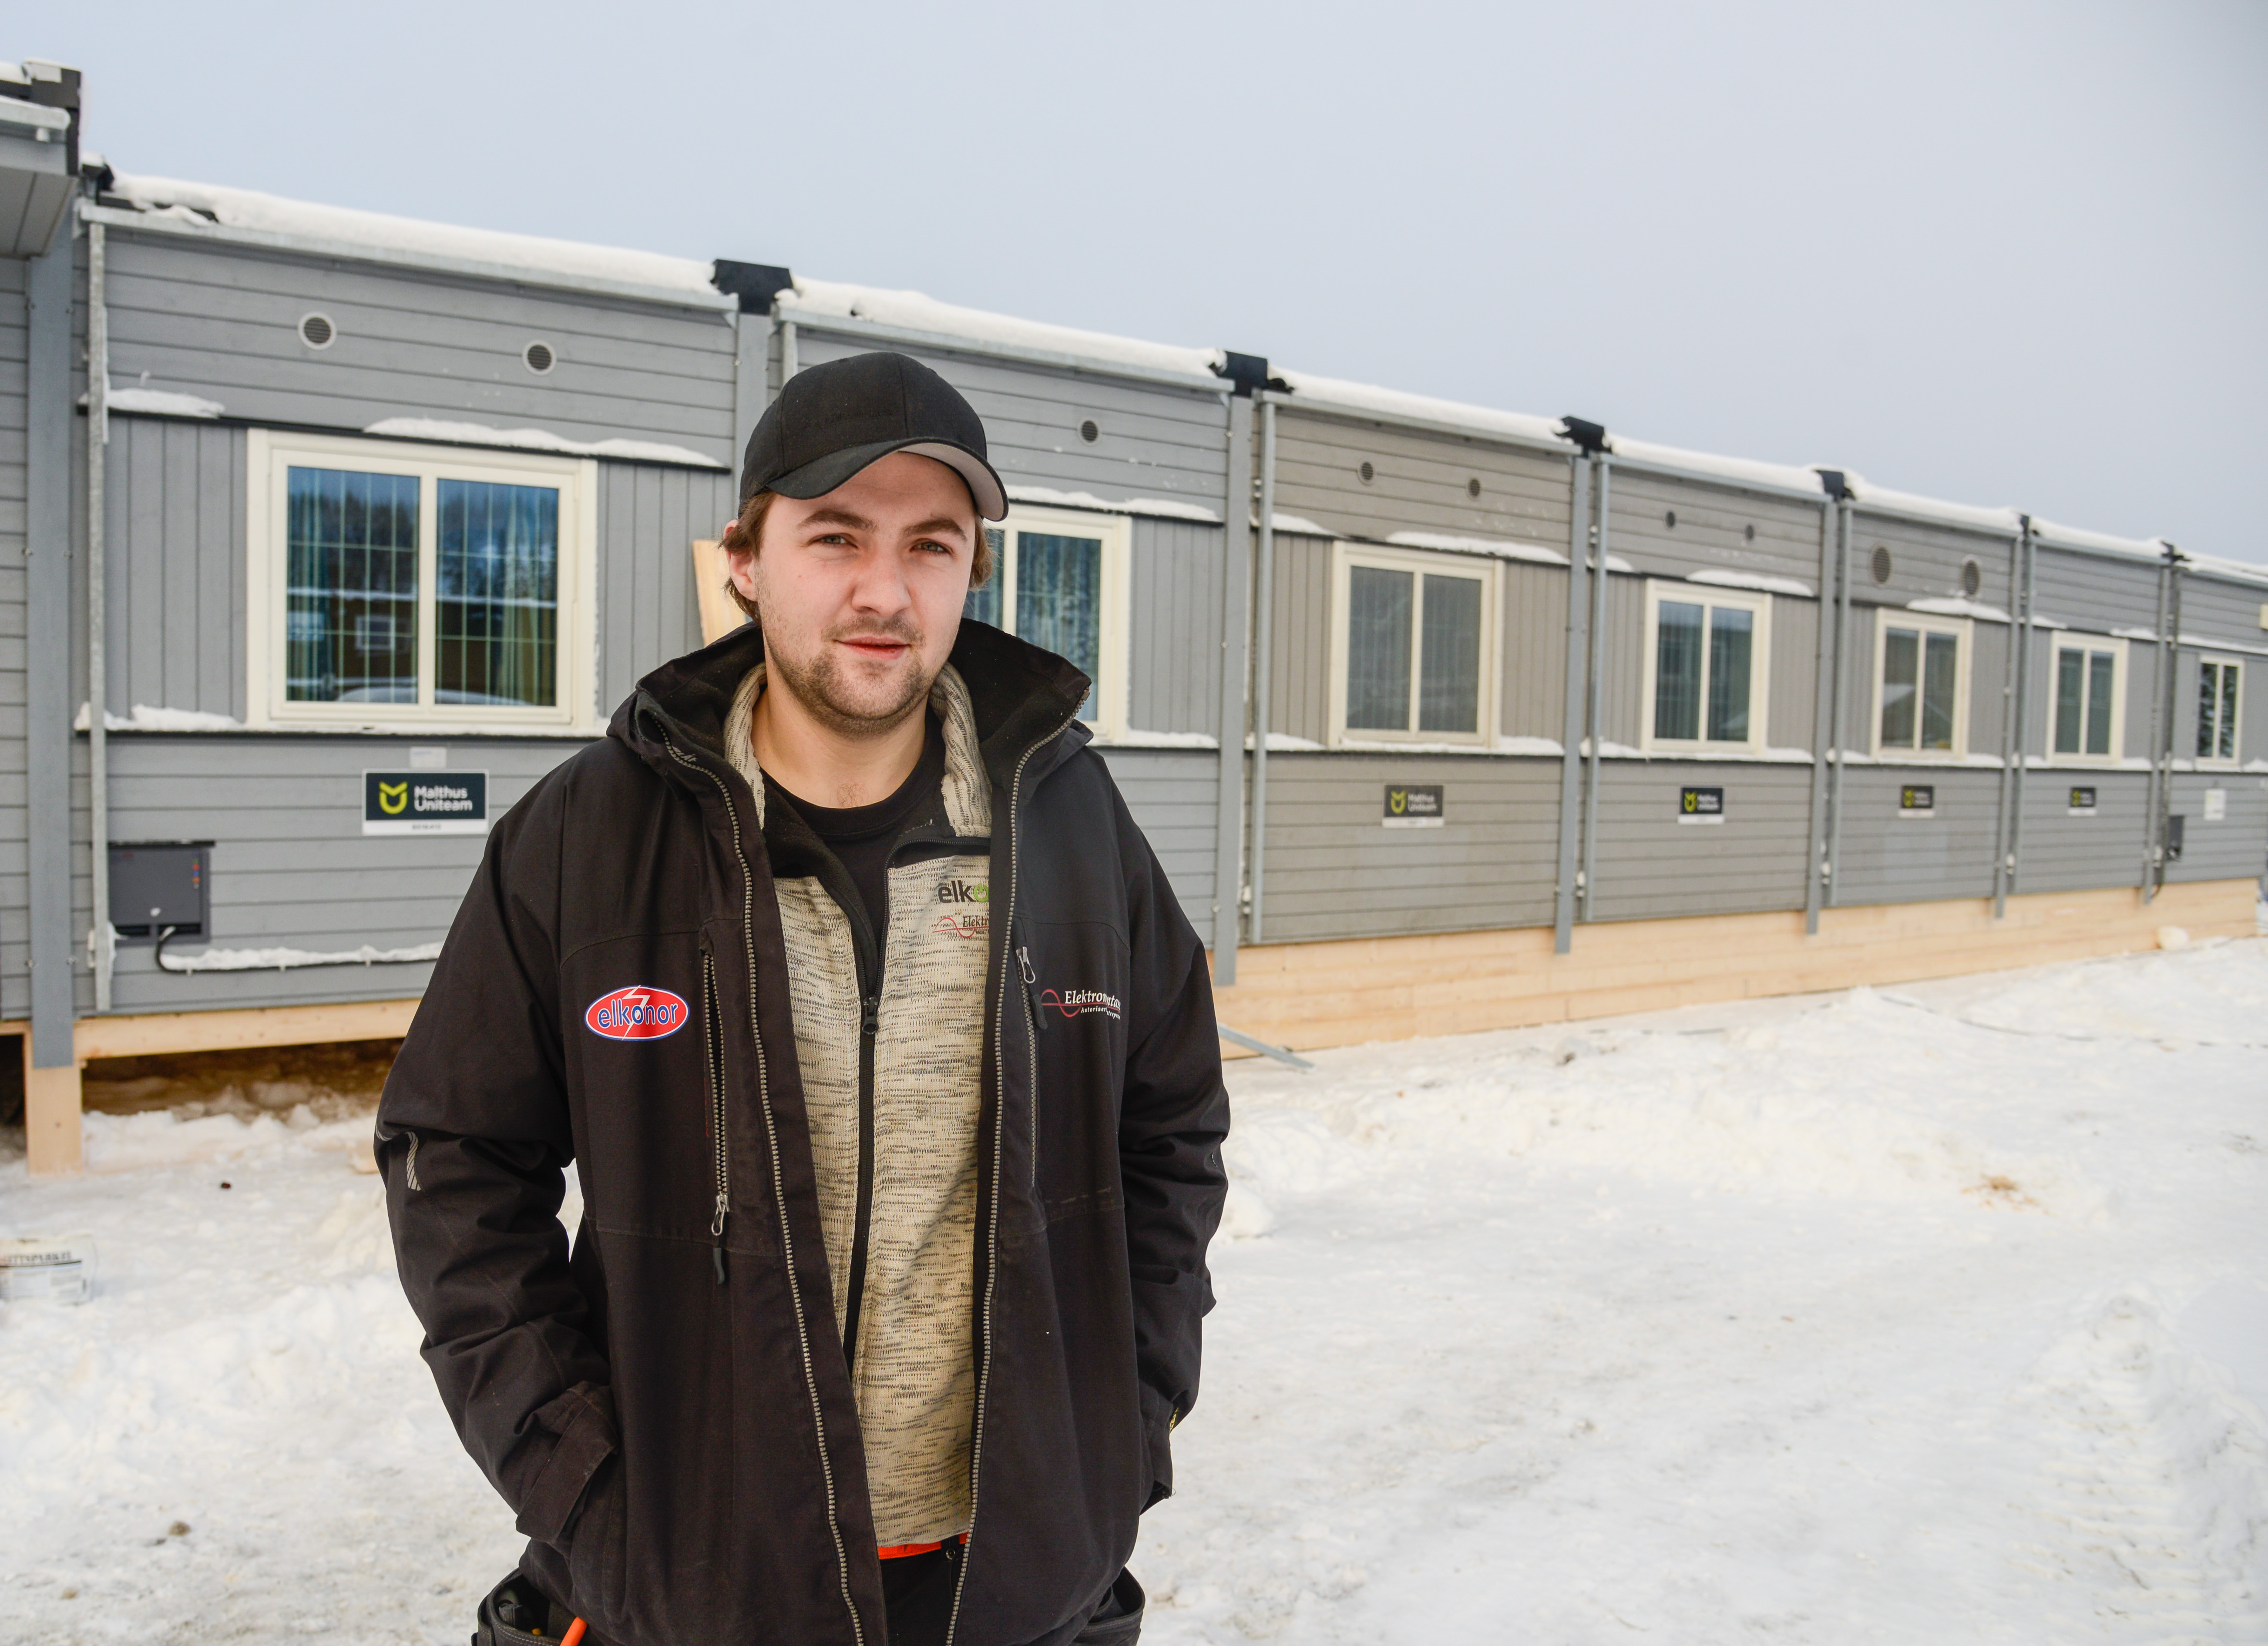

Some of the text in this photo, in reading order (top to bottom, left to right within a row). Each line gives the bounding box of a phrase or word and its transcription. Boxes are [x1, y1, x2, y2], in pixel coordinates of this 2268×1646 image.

[414, 785, 467, 799] Malthus
[414, 798, 473, 811] Uniteam
[598, 998, 678, 1029] elkonor
